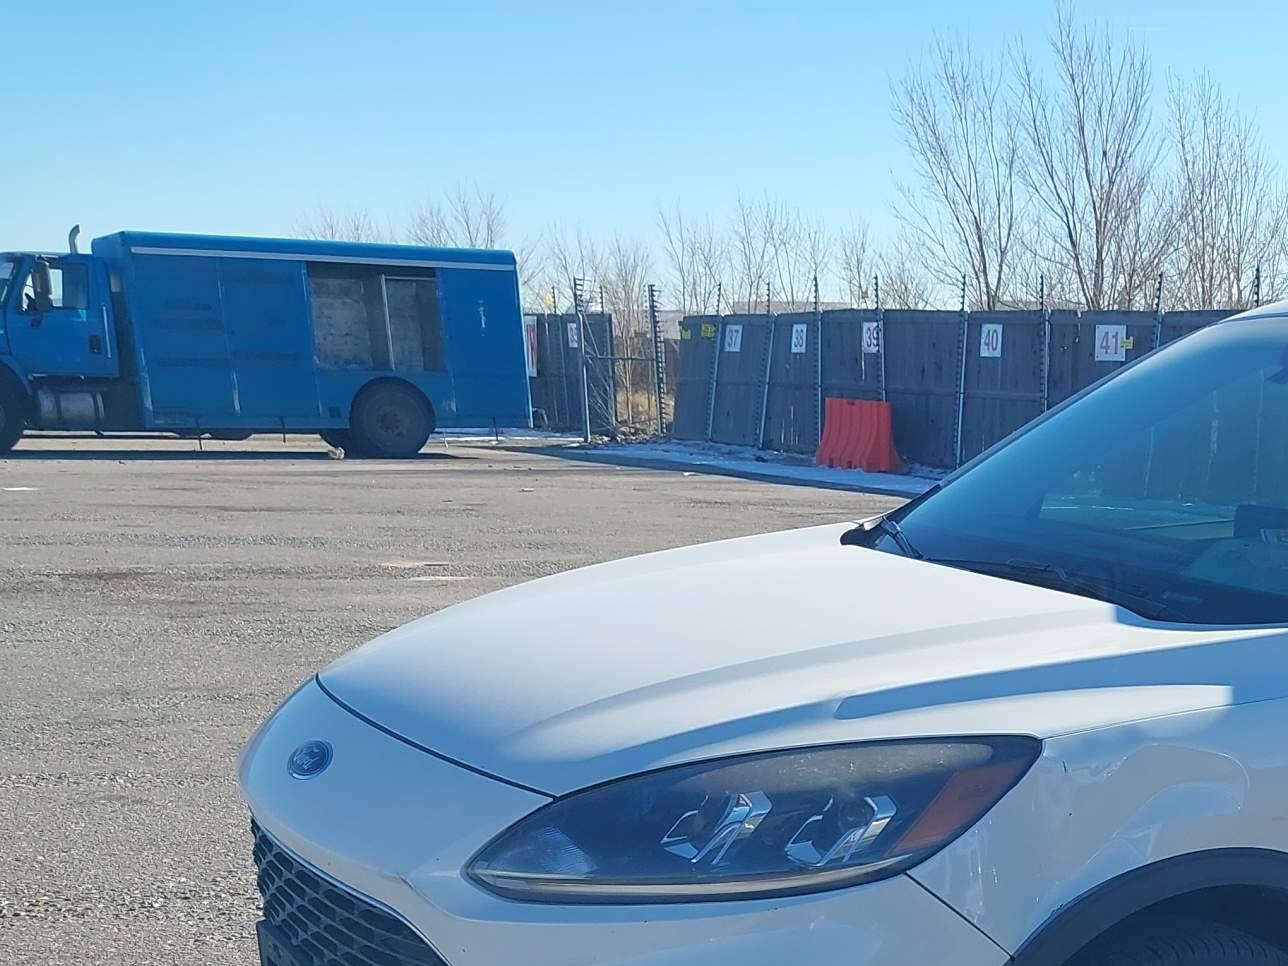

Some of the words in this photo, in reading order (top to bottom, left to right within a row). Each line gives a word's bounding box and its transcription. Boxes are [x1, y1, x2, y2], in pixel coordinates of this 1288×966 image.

[726, 327, 739, 348] 37
[865, 325, 880, 348] 39
[984, 329, 999, 352] 40
[1100, 331, 1119, 355] 41
